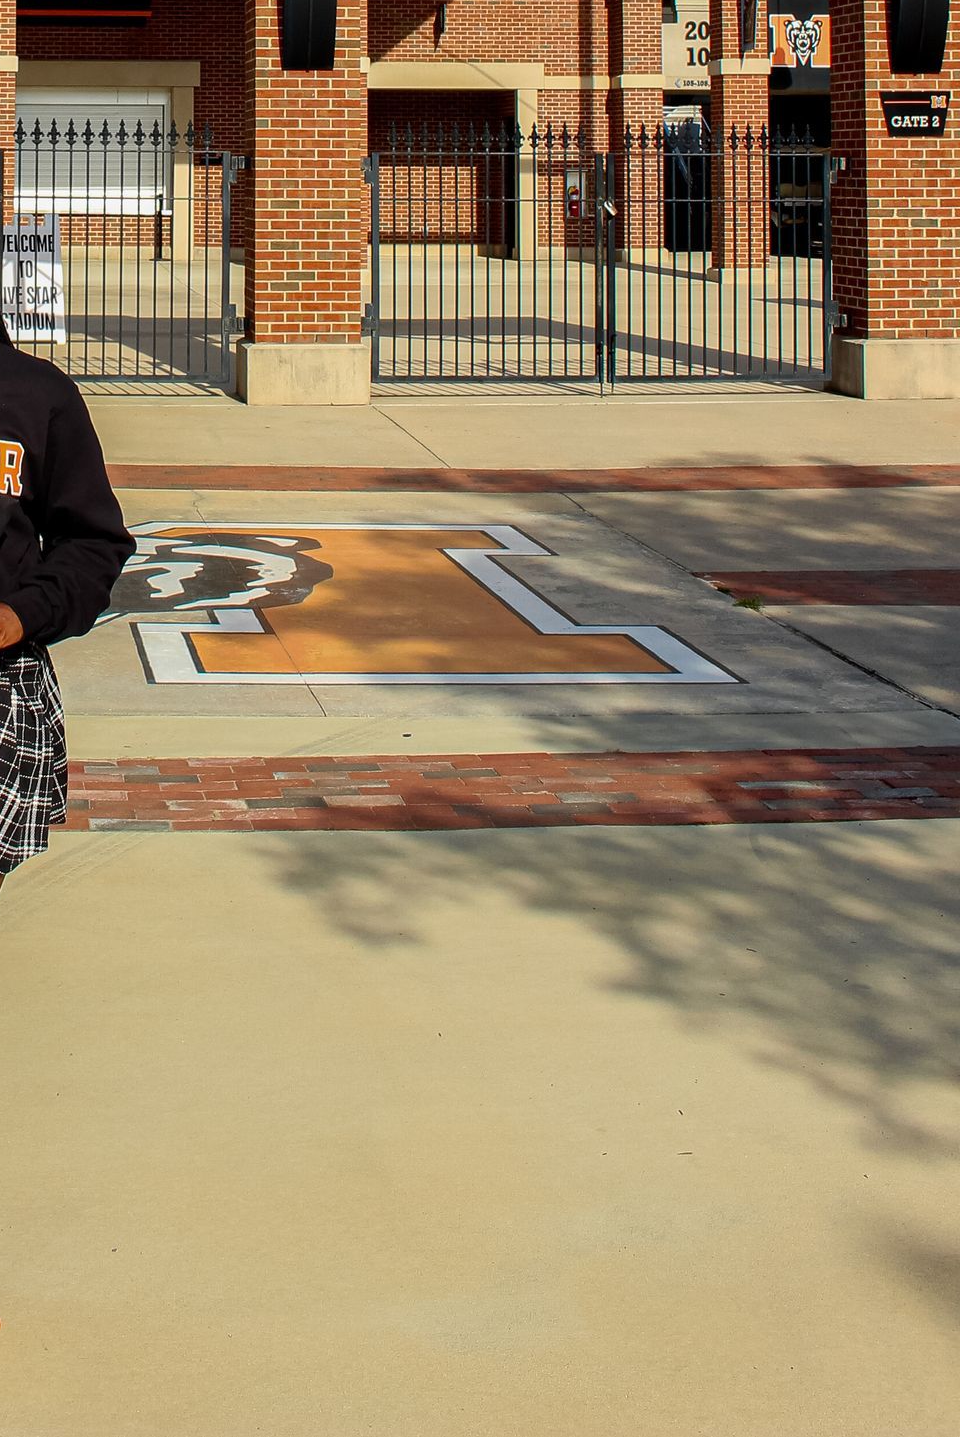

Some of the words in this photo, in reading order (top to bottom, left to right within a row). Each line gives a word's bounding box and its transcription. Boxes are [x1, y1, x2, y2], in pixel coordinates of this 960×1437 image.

[891, 115, 928, 127] GATE
[932, 115, 940, 127] 2
[19, 260, 33, 278] TO
[3, 286, 22, 304] IVE
[27, 286, 58, 304] STAR
